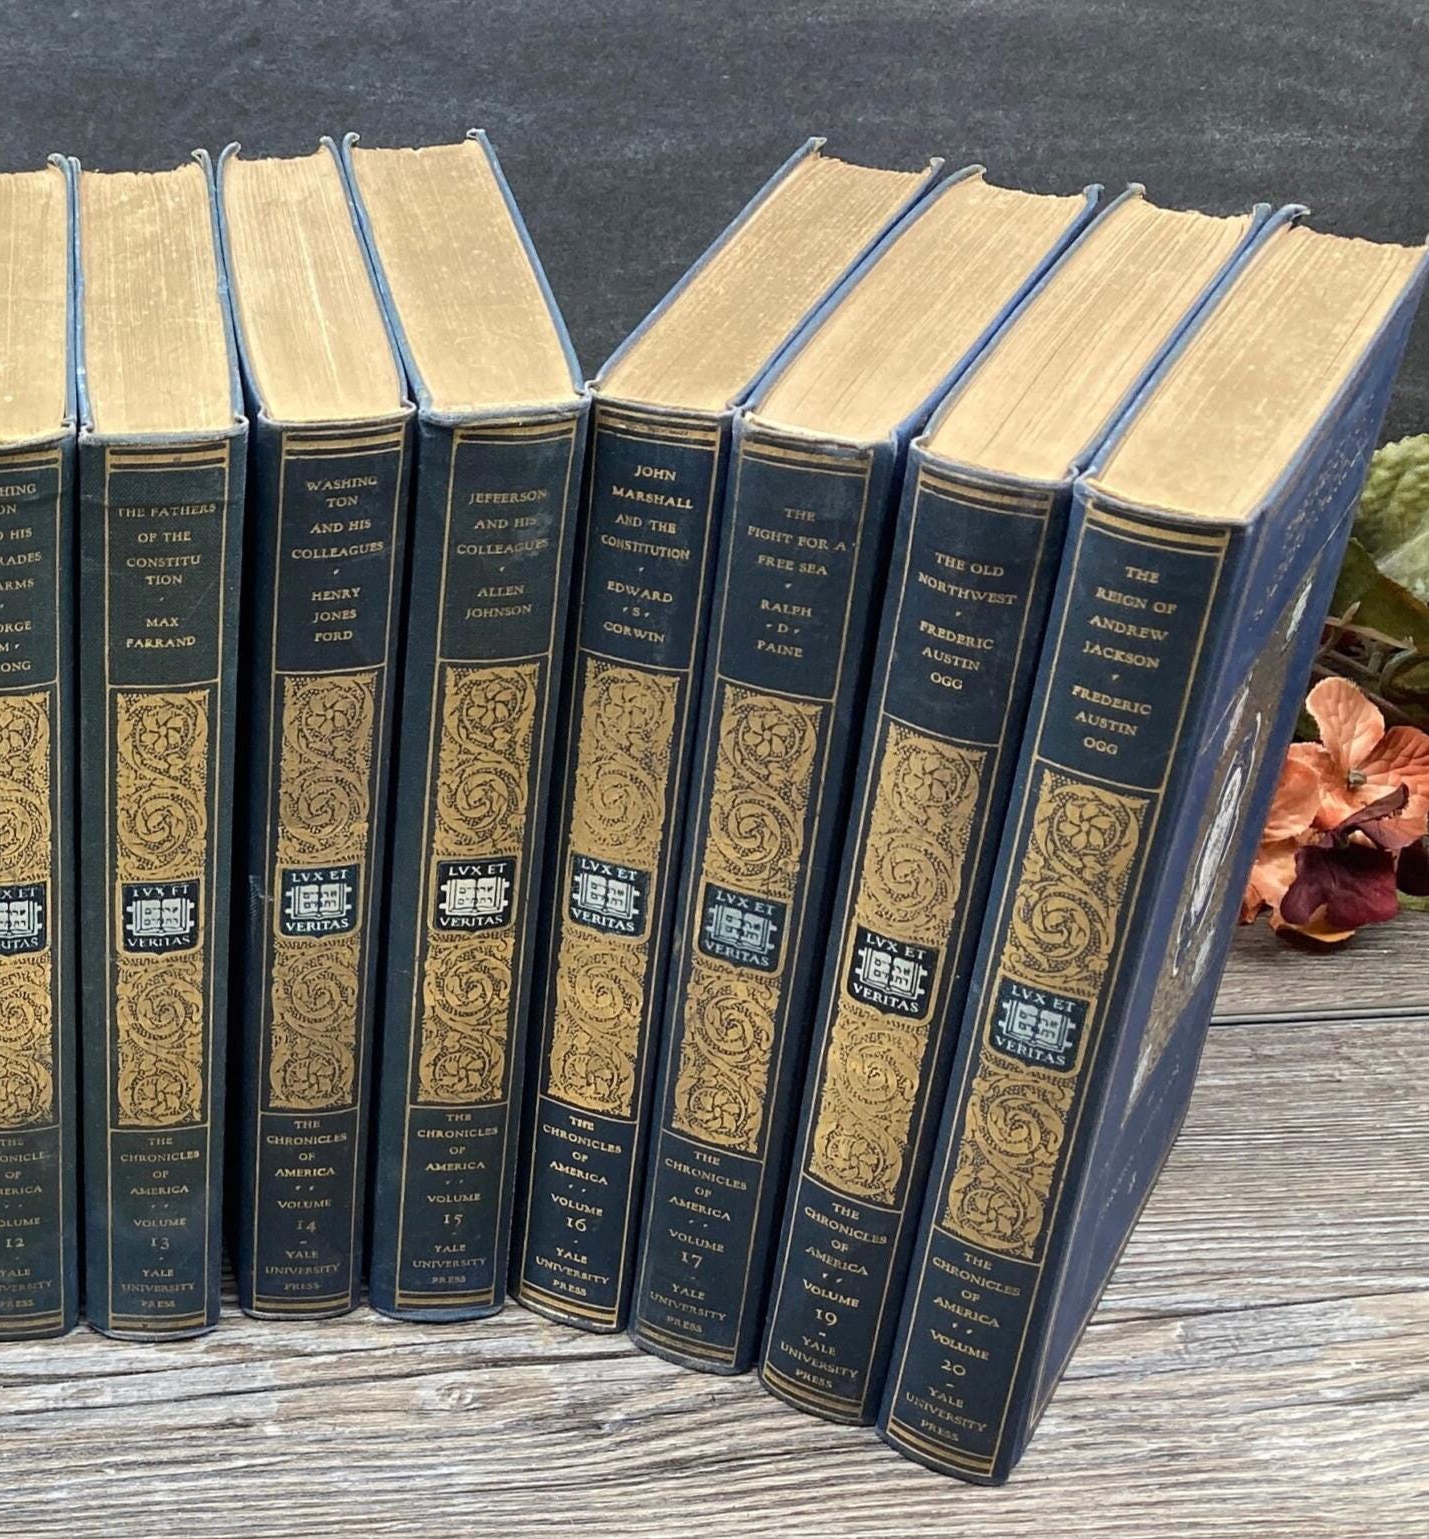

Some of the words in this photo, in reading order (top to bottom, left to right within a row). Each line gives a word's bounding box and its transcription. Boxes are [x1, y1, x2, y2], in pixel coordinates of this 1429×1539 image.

[633, 464, 677, 482] JOHN
[306, 475, 378, 492] WASHING
[325, 495, 359, 509] TON
[468, 489, 548, 505] JEFFERSON
[611, 484, 694, 510] MARSHALL
[118, 508, 146, 518] THE
[150, 503, 217, 518] FATHERS
[783, 507, 816, 522] THE
[309, 521, 344, 535] AND
[347, 518, 372, 532] HIS
[473, 518, 510, 531] AND
[614, 513, 643, 528] AND
[647, 519, 677, 535] THE
[9, 527, 33, 541] HIS
[137, 532, 158, 544] OF
[161, 530, 192, 543] THE
[747, 524, 794, 545] FIGHT
[797, 535, 829, 551] FOR
[291, 540, 387, 560] COLLEAGUES
[456, 538, 549, 557] COLLEAGUES
[600, 534, 691, 561] CONSTITUTION
[126, 554, 202, 568] CONSTITU
[756, 554, 795, 572] FREE
[798, 562, 828, 576] SEA
[934, 551, 966, 572] THE
[969, 563, 1005, 577] OLD
[144, 574, 183, 586] TION
[1124, 565, 1161, 585] THE
[310, 586, 361, 602] HENRY
[476, 584, 525, 598] ALLEN
[606, 580, 674, 603] EDWARD
[917, 571, 1018, 605] NORTHWEST
[760, 598, 813, 618] RALPH
[1094, 586, 1149, 610] REIGN
[1151, 601, 1178, 615] OF
[311, 608, 358, 624] JONES
[464, 603, 533, 620] JOHNSON
[145, 616, 180, 628] MAX
[1088, 614, 1170, 642] ANDREW
[125, 635, 197, 649] FARRAND
[313, 629, 354, 643] FORD
[602, 621, 666, 644] CORWIN
[918, 619, 995, 650] FREDERIC
[756, 639, 803, 658] PAINE
[1082, 640, 1161, 669] JACKSON
[921, 646, 981, 672] AUSTIN
[929, 671, 963, 691] OGG
[1071, 684, 1153, 716] FREDERIC
[1074, 710, 1139, 737] AUSTIN
[1083, 736, 1119, 756] OGG
[488, 862, 505, 874] ET
[440, 915, 503, 928] VERITAS
[904, 946, 926, 960] ET
[853, 983, 920, 1013] VERITAS
[416, 1126, 499, 1139] CHRONICLES
[568, 1115, 595, 1132] THE
[542, 1123, 622, 1155] CHRONICLES
[571, 1150, 589, 1163] OF
[274, 1166, 336, 1178] AMERICA
[549, 1160, 609, 1186] AMERICA
[550, 1192, 604, 1217] VOLUME
[566, 1216, 587, 1233] 16
[668, 1228, 725, 1253] VOLUME
[555, 1246, 588, 1265] YALE
[681, 1250, 703, 1269] 17
[804, 1246, 869, 1277] AMERICA
[535, 1255, 610, 1285] UNIVERSITY
[932, 1256, 1021, 1297] CHRONICLES
[552, 1278, 587, 1297] PRESS
[802, 1278, 860, 1308] VOLUME
[815, 1308, 838, 1327] 19
[932, 1296, 1000, 1329] AMERICA
[929, 1328, 990, 1361] VOLUME
[940, 1358, 967, 1377] 20
